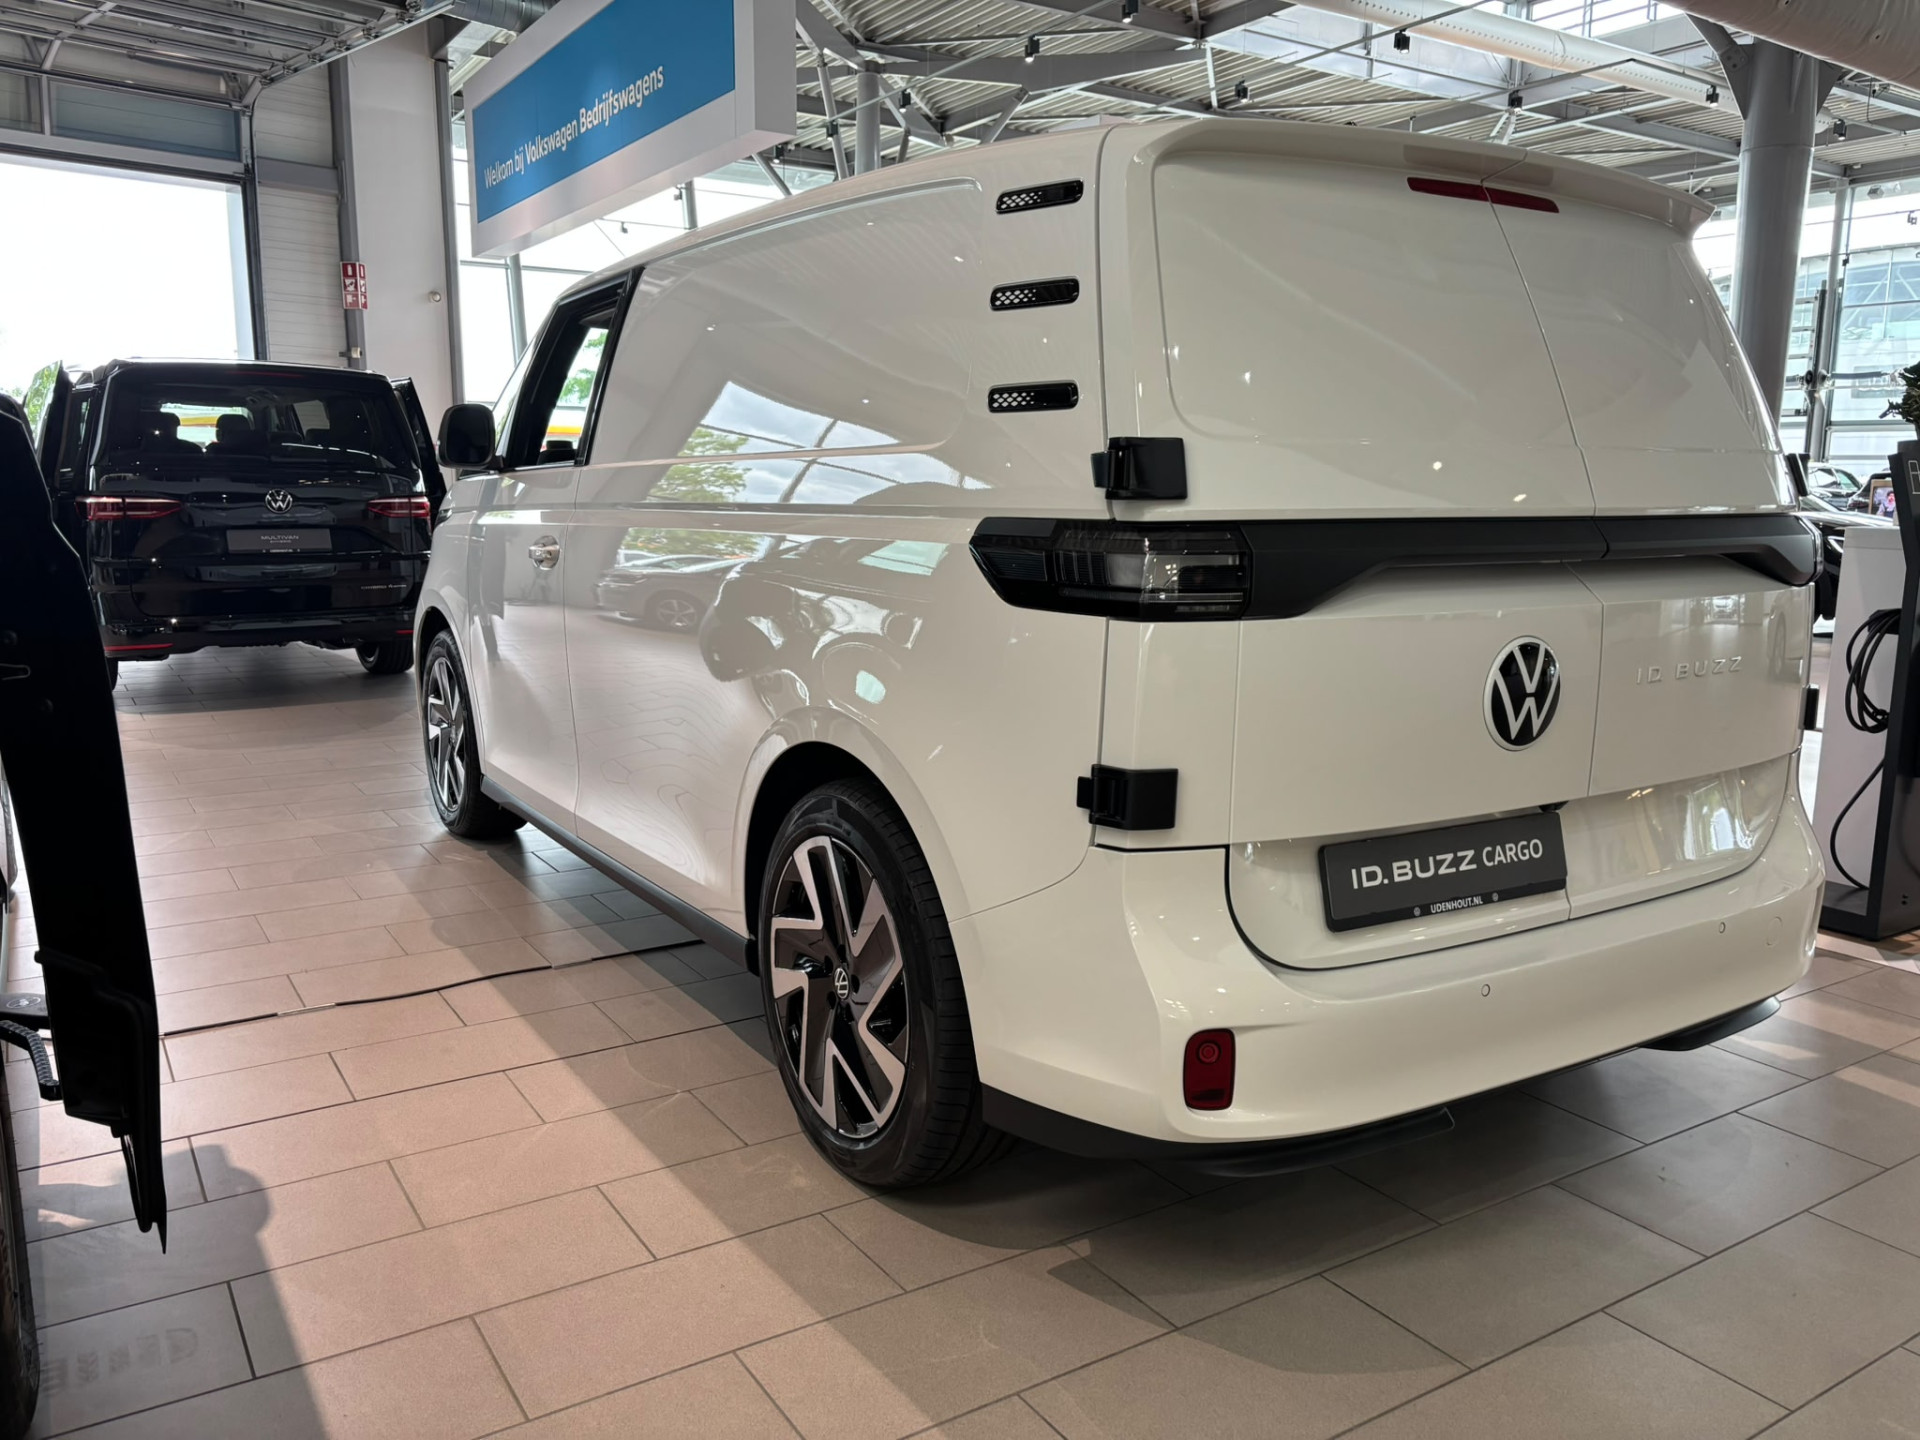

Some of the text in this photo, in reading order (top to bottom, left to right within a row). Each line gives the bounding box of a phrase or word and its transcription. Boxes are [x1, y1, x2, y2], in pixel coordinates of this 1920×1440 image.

[484, 65, 664, 189] Welkom bij Volkswagen Bedrijfswagens
[265, 488, 292, 513] VW
[1675, 656, 1742, 679] BUZZ
[1484, 637, 1560, 750] VW
[1482, 838, 1543, 867] CARGO
[1430, 895, 1484, 914] UDENHOUT.NL
